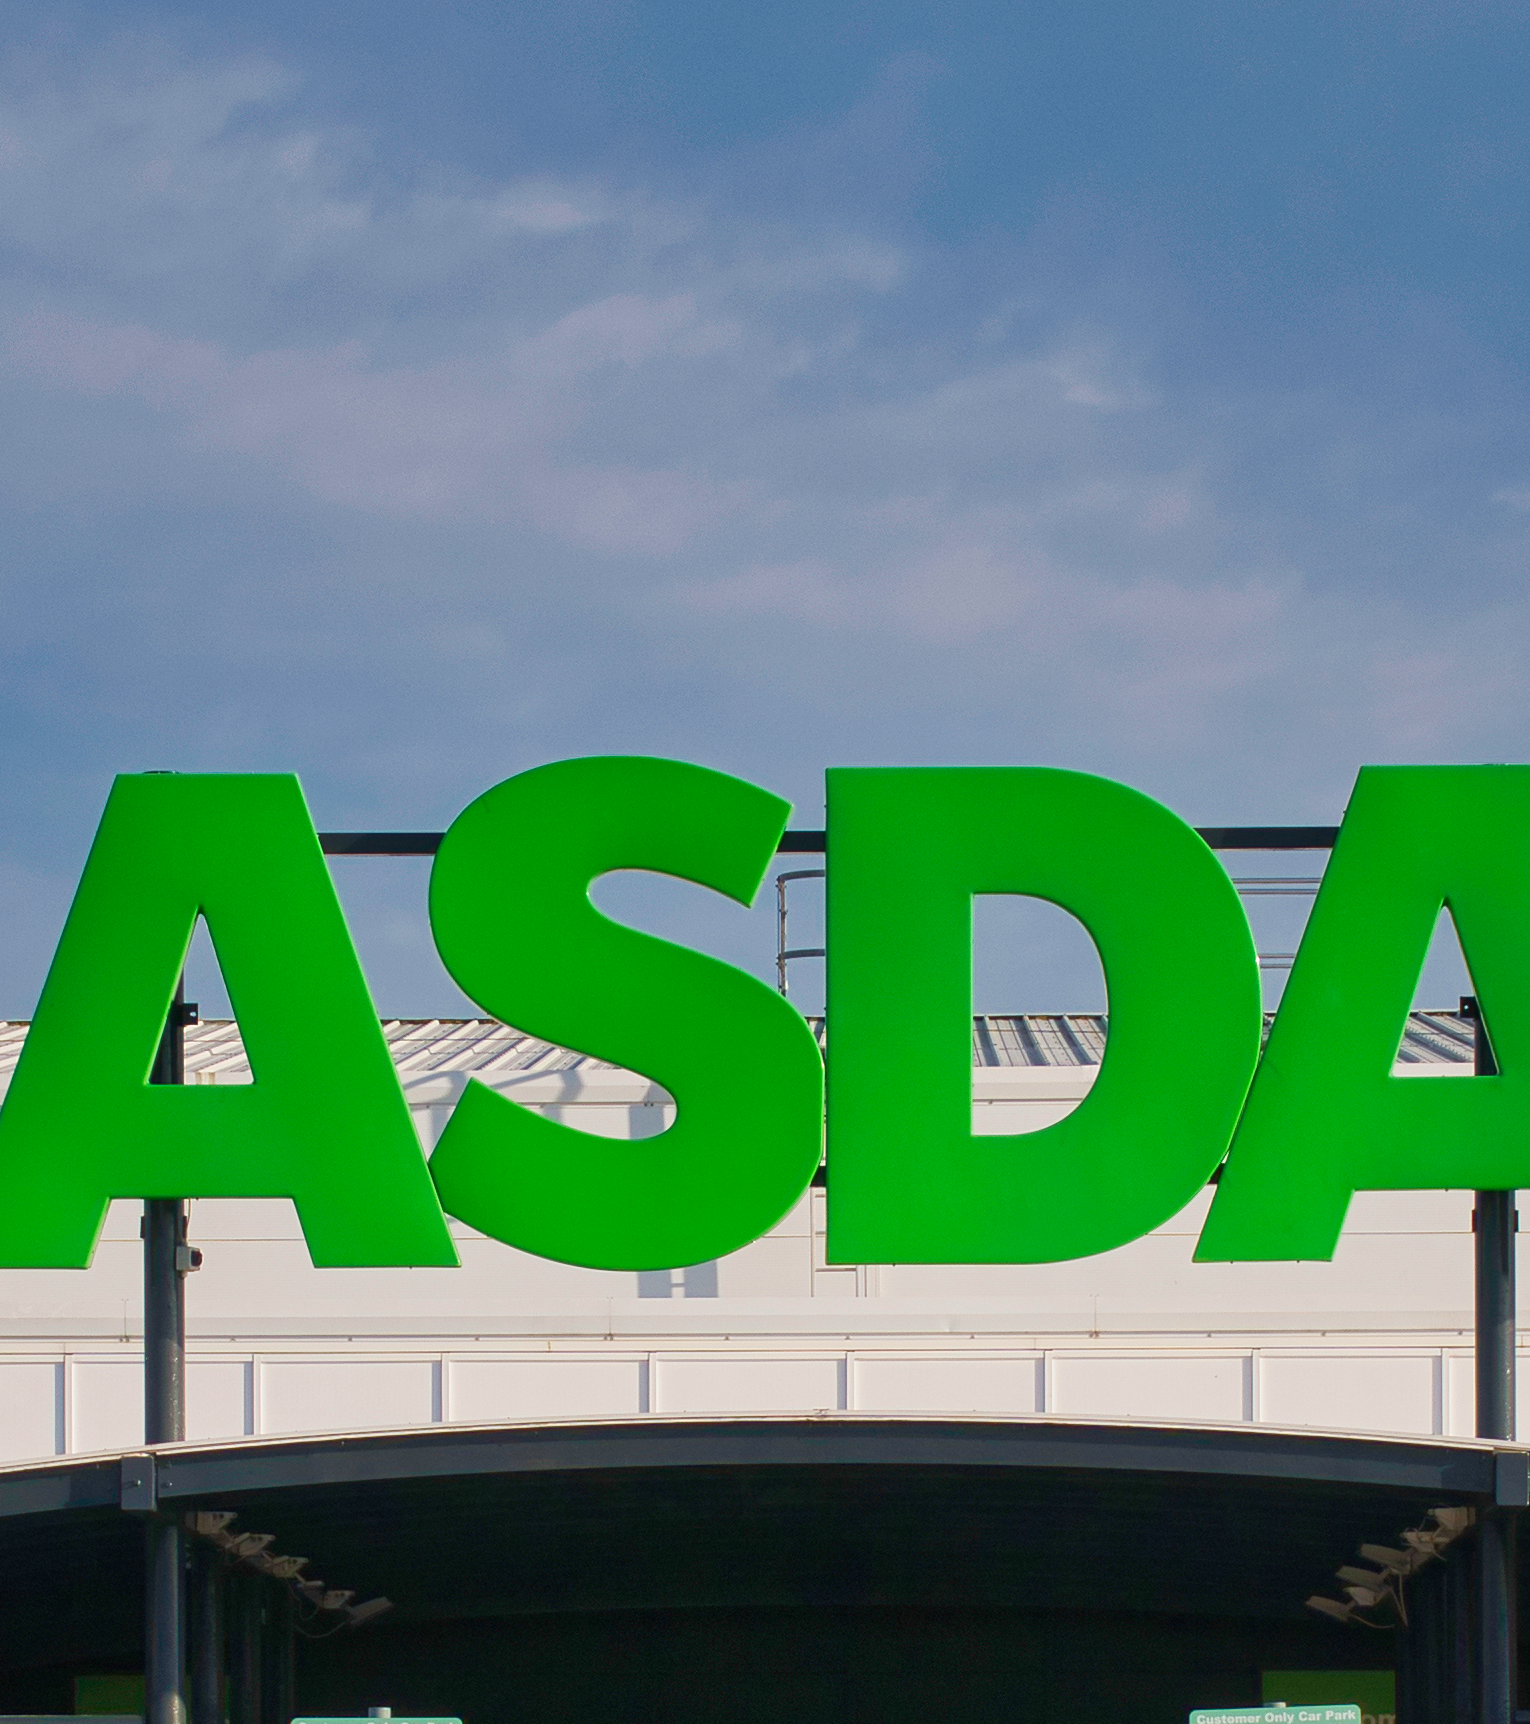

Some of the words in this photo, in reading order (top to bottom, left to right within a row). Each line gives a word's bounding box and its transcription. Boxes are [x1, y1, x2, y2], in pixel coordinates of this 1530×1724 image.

[1196, 1714, 1260, 1724] Customer
[1264, 1712, 1295, 1724] Only
[1298, 1711, 1322, 1722] Car
[1325, 1710, 1356, 1721] Park
